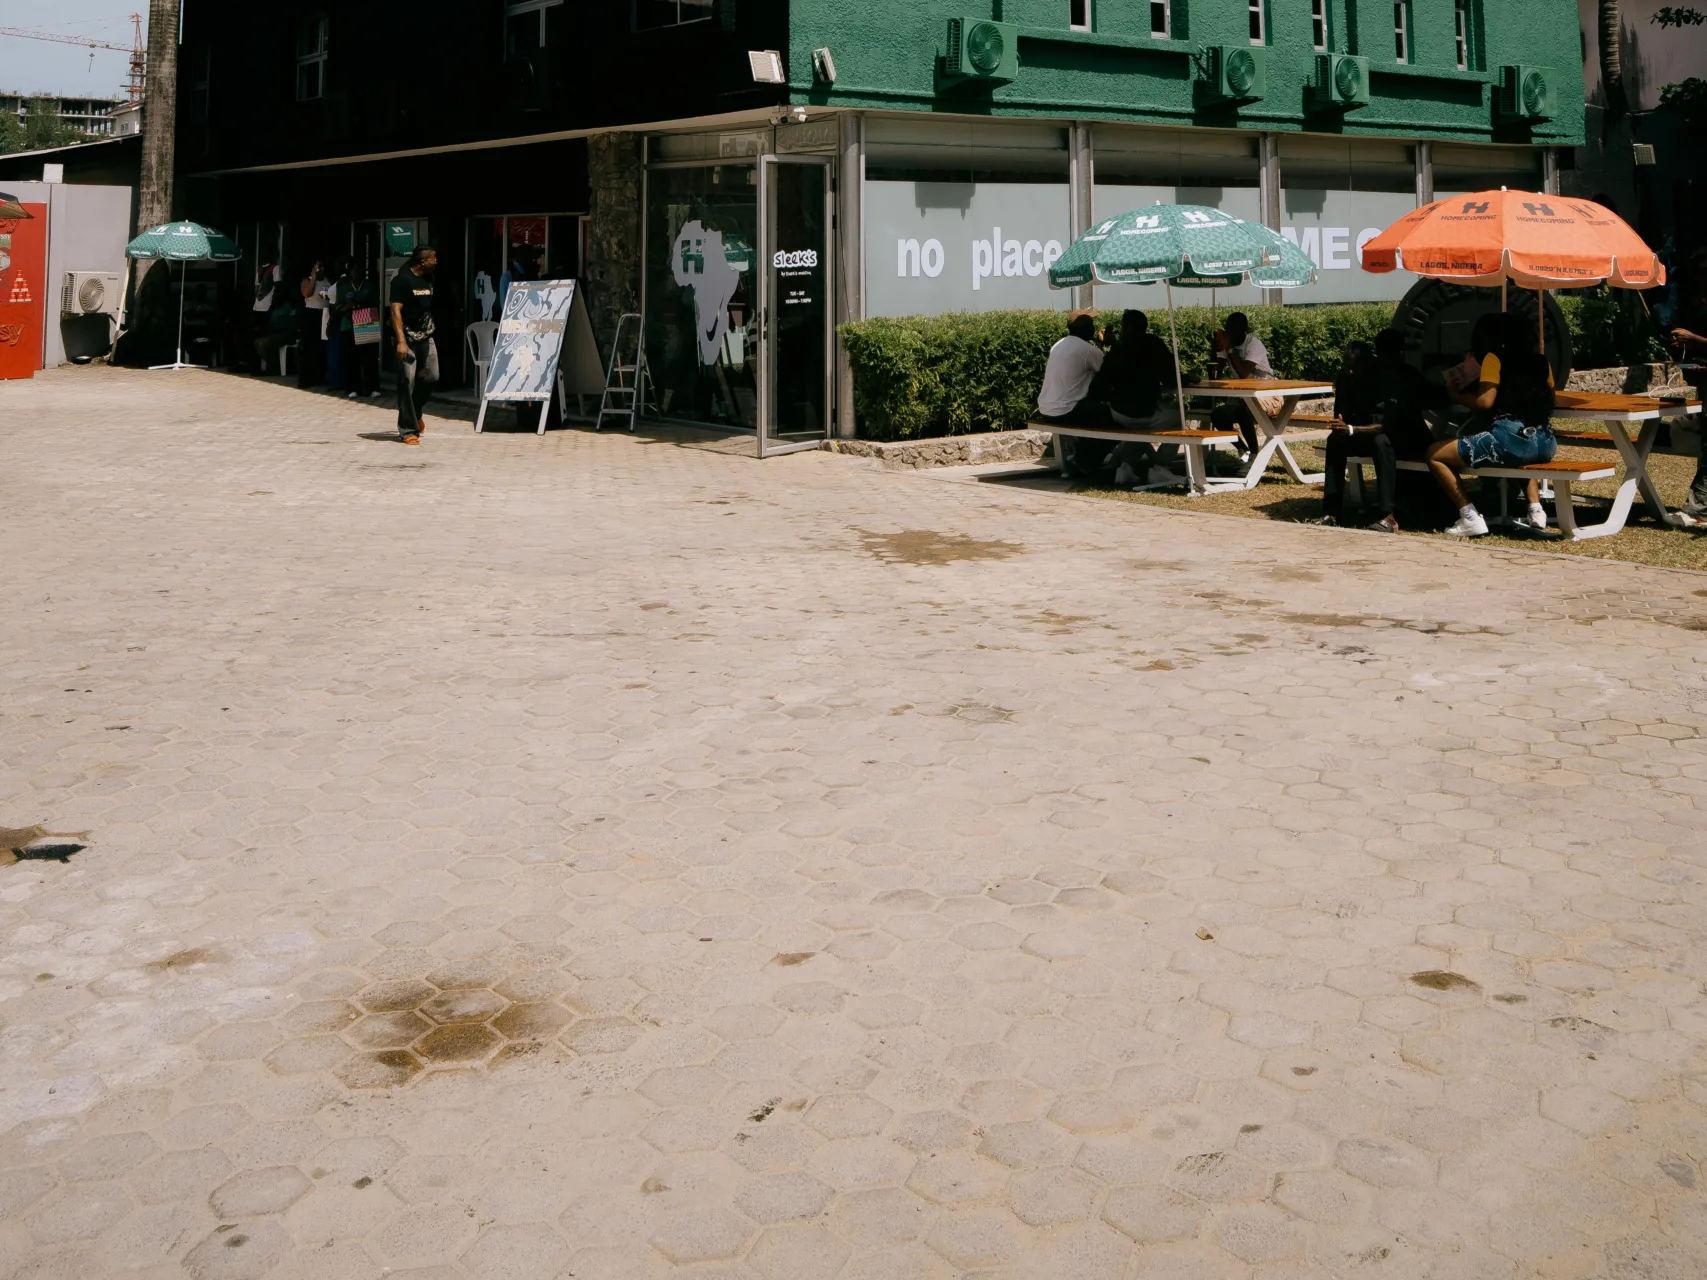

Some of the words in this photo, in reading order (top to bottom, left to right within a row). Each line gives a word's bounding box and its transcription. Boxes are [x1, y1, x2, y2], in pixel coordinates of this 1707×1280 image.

[1516, 216, 1575, 224] HOMECOMING
[898, 238, 944, 278] no
[972, 226, 1063, 291] place
[1451, 262, 1483, 270] NIGERIA
